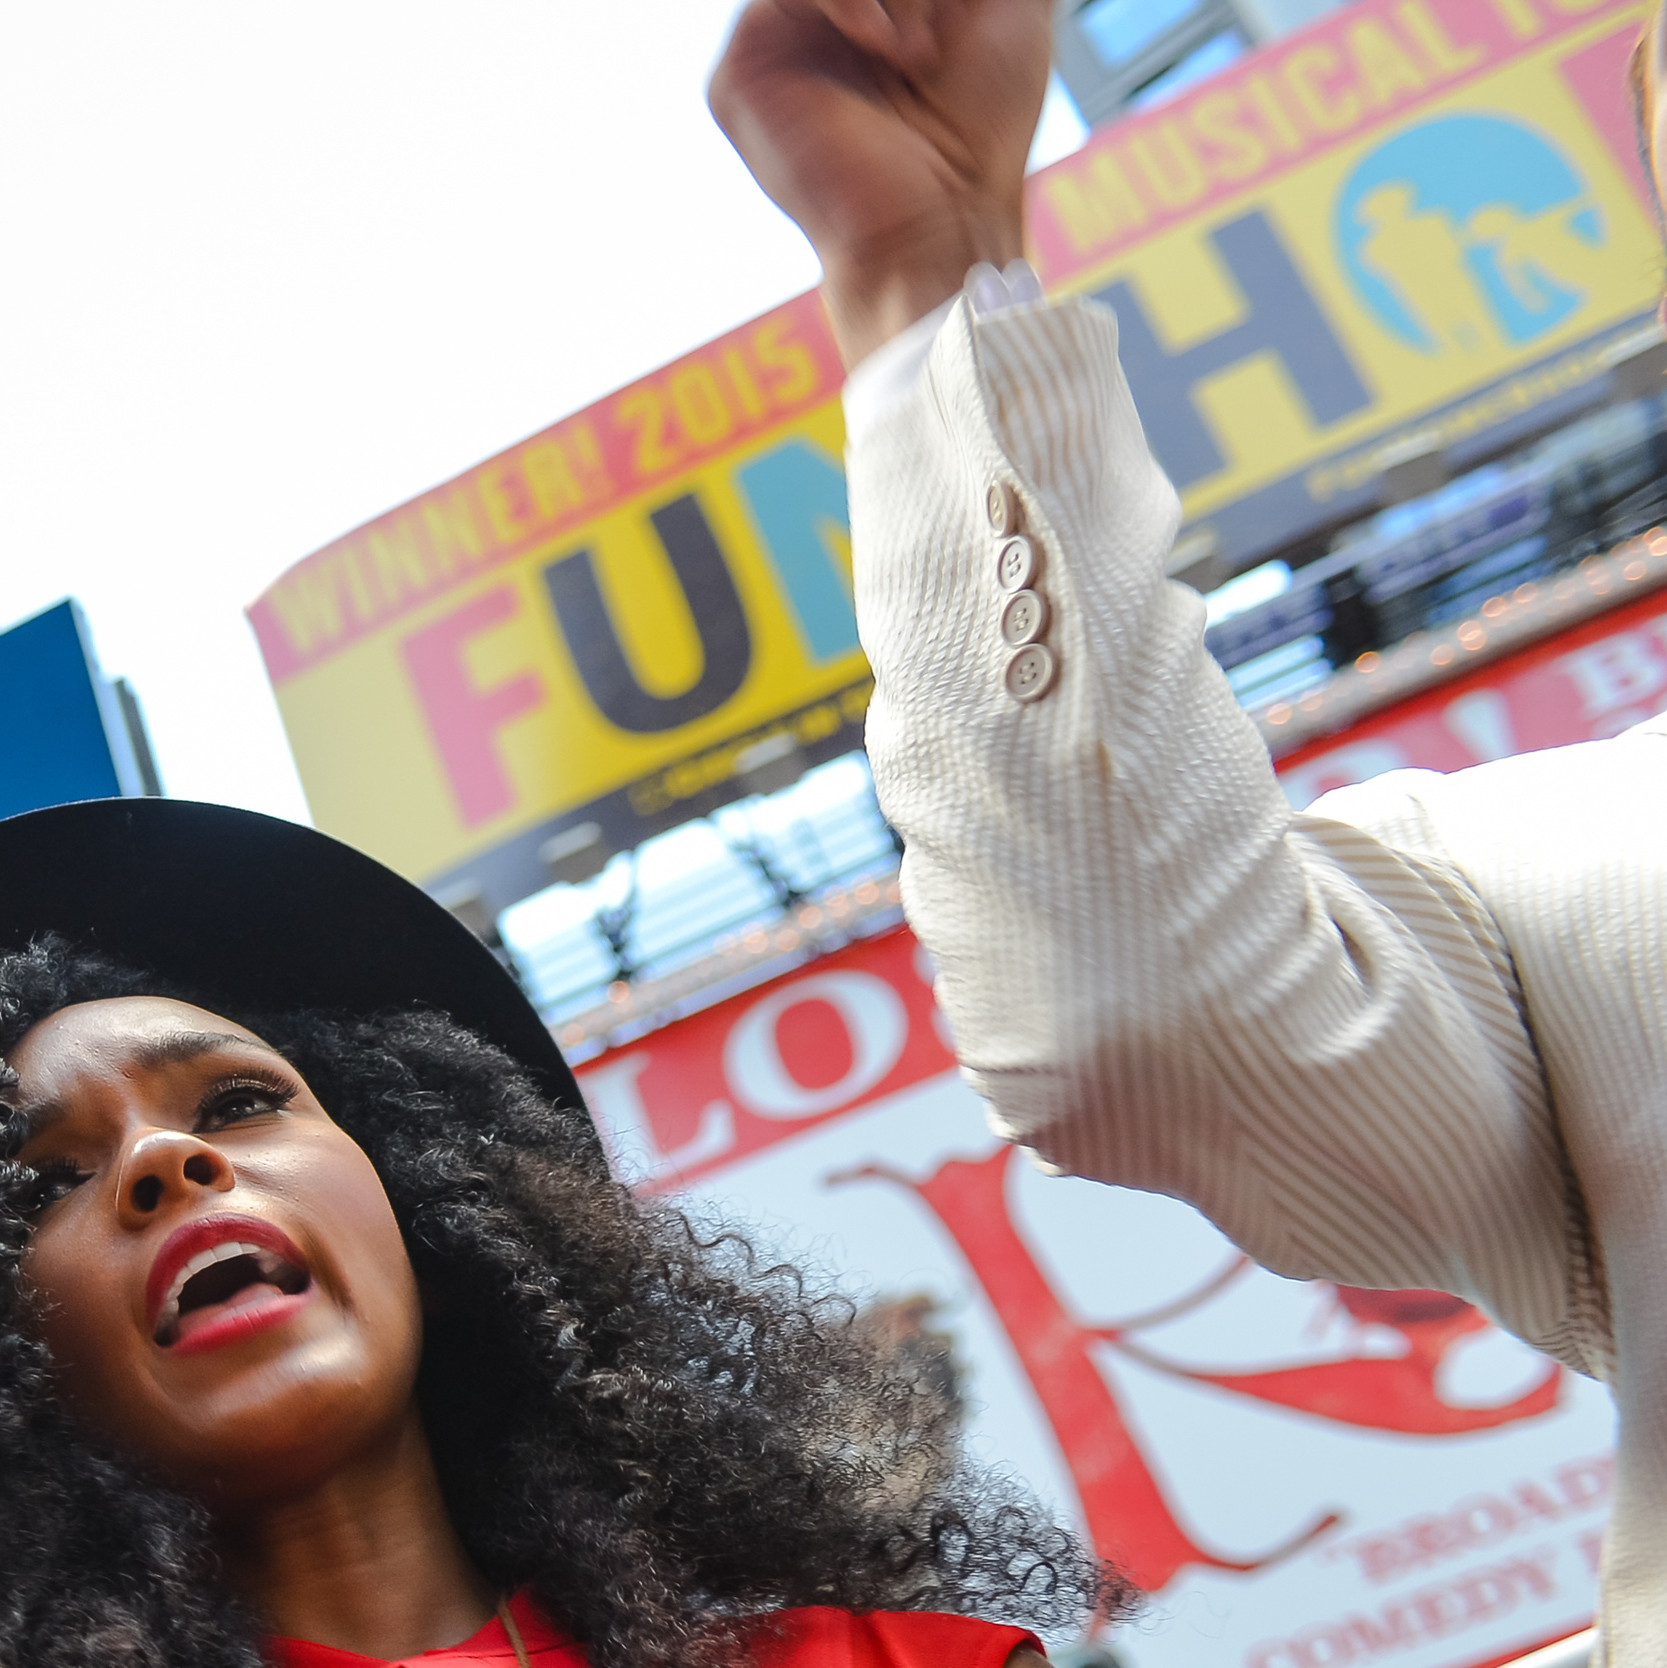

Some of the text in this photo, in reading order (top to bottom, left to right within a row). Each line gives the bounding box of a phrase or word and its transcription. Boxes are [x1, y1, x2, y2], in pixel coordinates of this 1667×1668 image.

[1044, 0, 1487, 254] MUSICAL
[269, 313, 819, 657] WINNER! 2015
